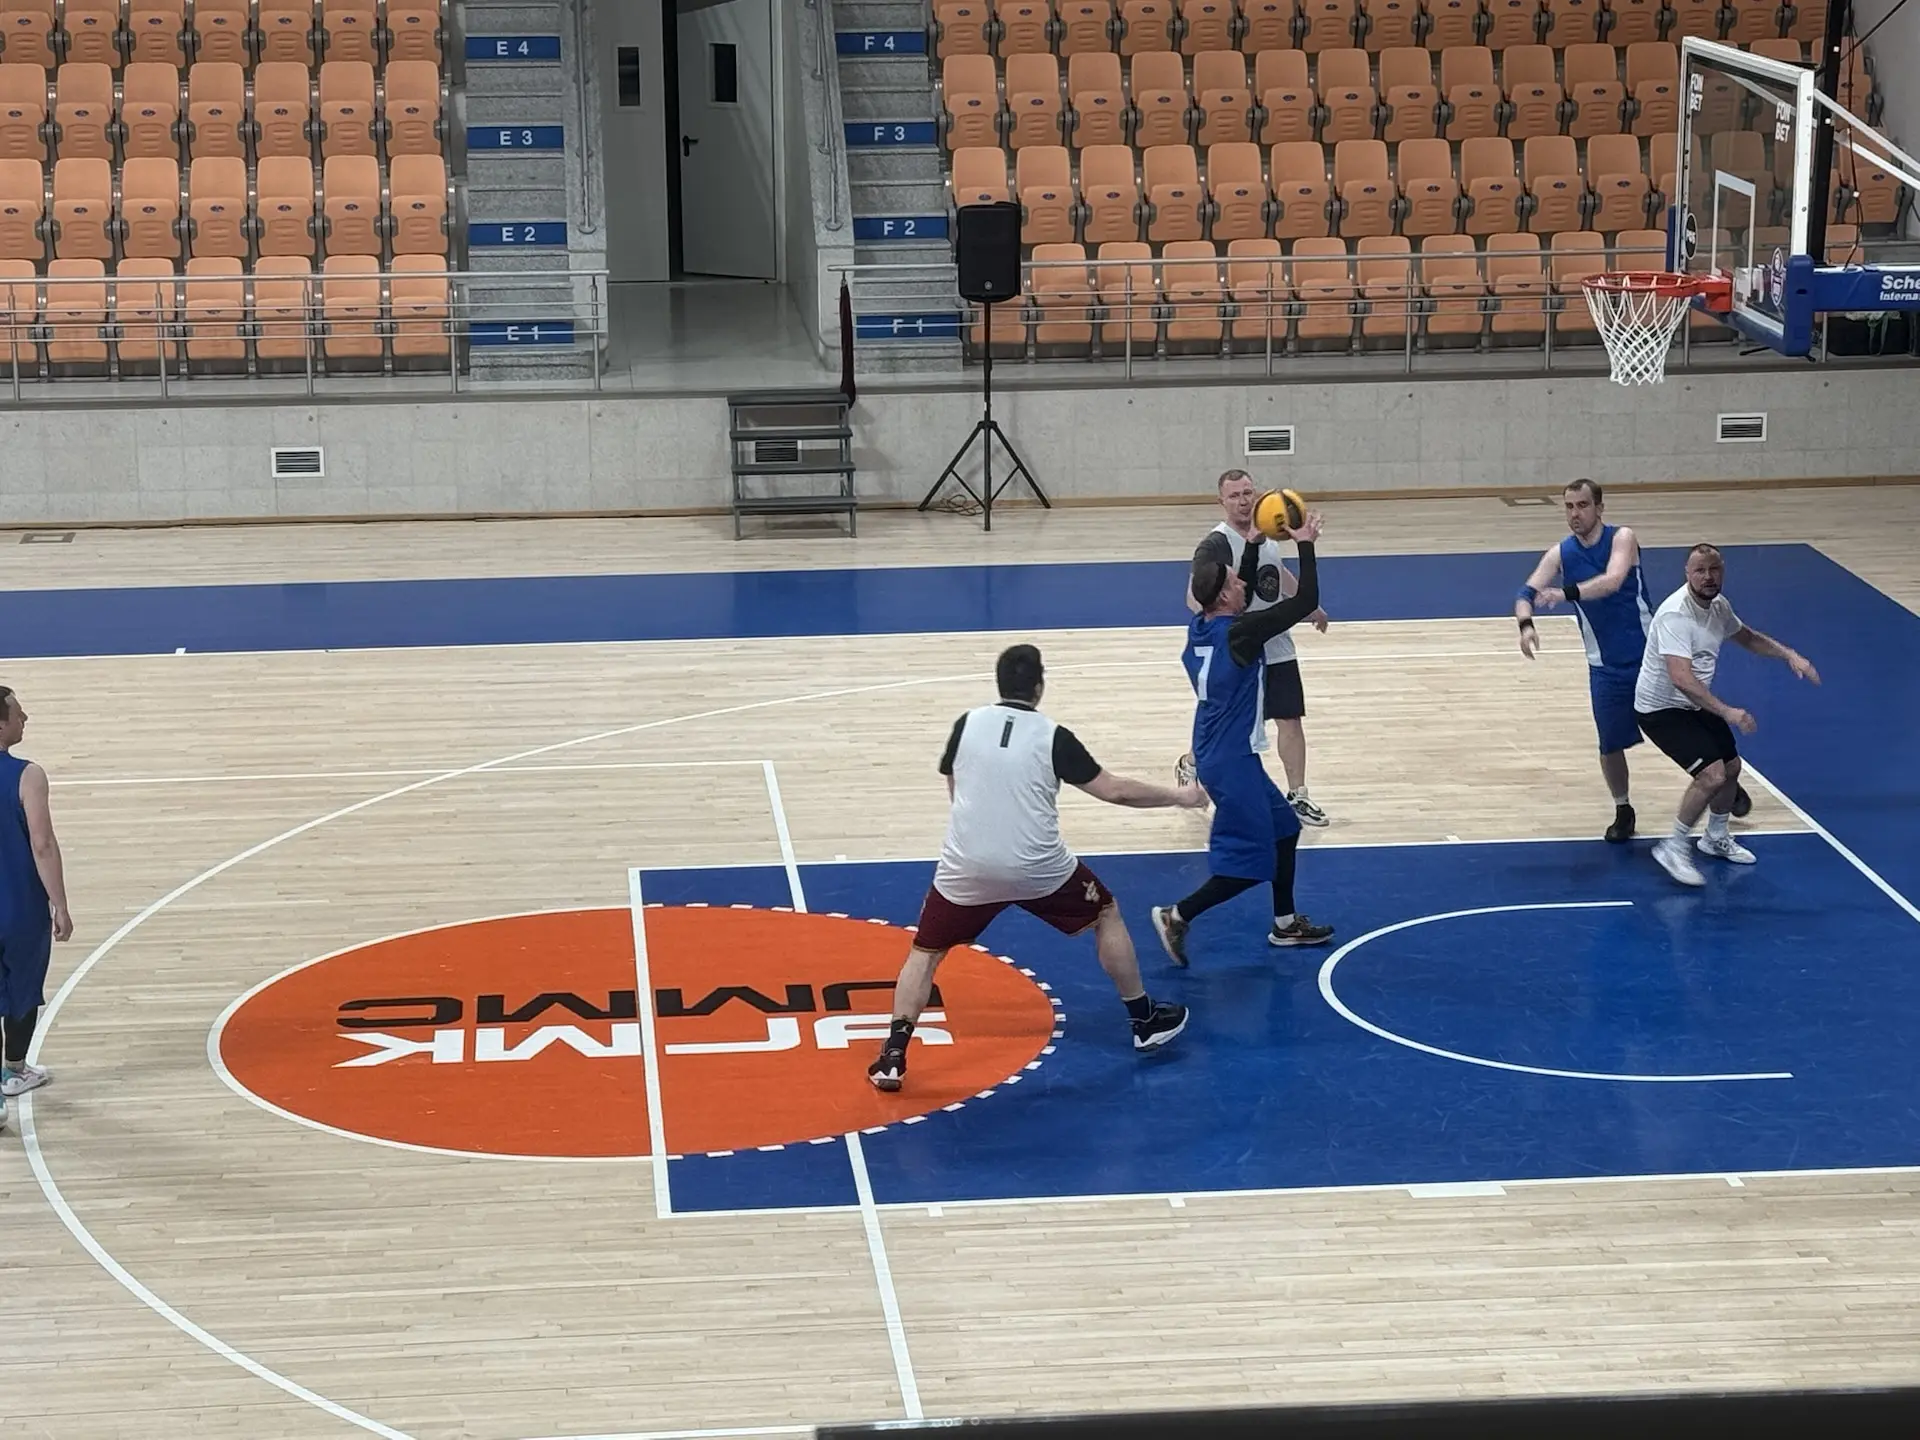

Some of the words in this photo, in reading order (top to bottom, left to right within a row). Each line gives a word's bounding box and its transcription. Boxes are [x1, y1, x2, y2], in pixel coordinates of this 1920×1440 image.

[497, 41, 509, 55] E
[517, 41, 529, 55] 4
[864, 36, 875, 51] F
[884, 35, 895, 51] 4
[500, 131, 512, 145] E
[521, 130, 533, 145] 3
[874, 126, 885, 141] F
[894, 126, 905, 141] 3
[502, 227, 514, 242] E
[524, 226, 536, 242] 2
[883, 221, 894, 236] F
[904, 220, 915, 235] 2
[507, 325, 519, 341] E
[531, 325, 539, 341] 1
[892, 318, 904, 334] F
[916, 318, 923, 334] 1
[1193, 645, 1215, 701] 7
